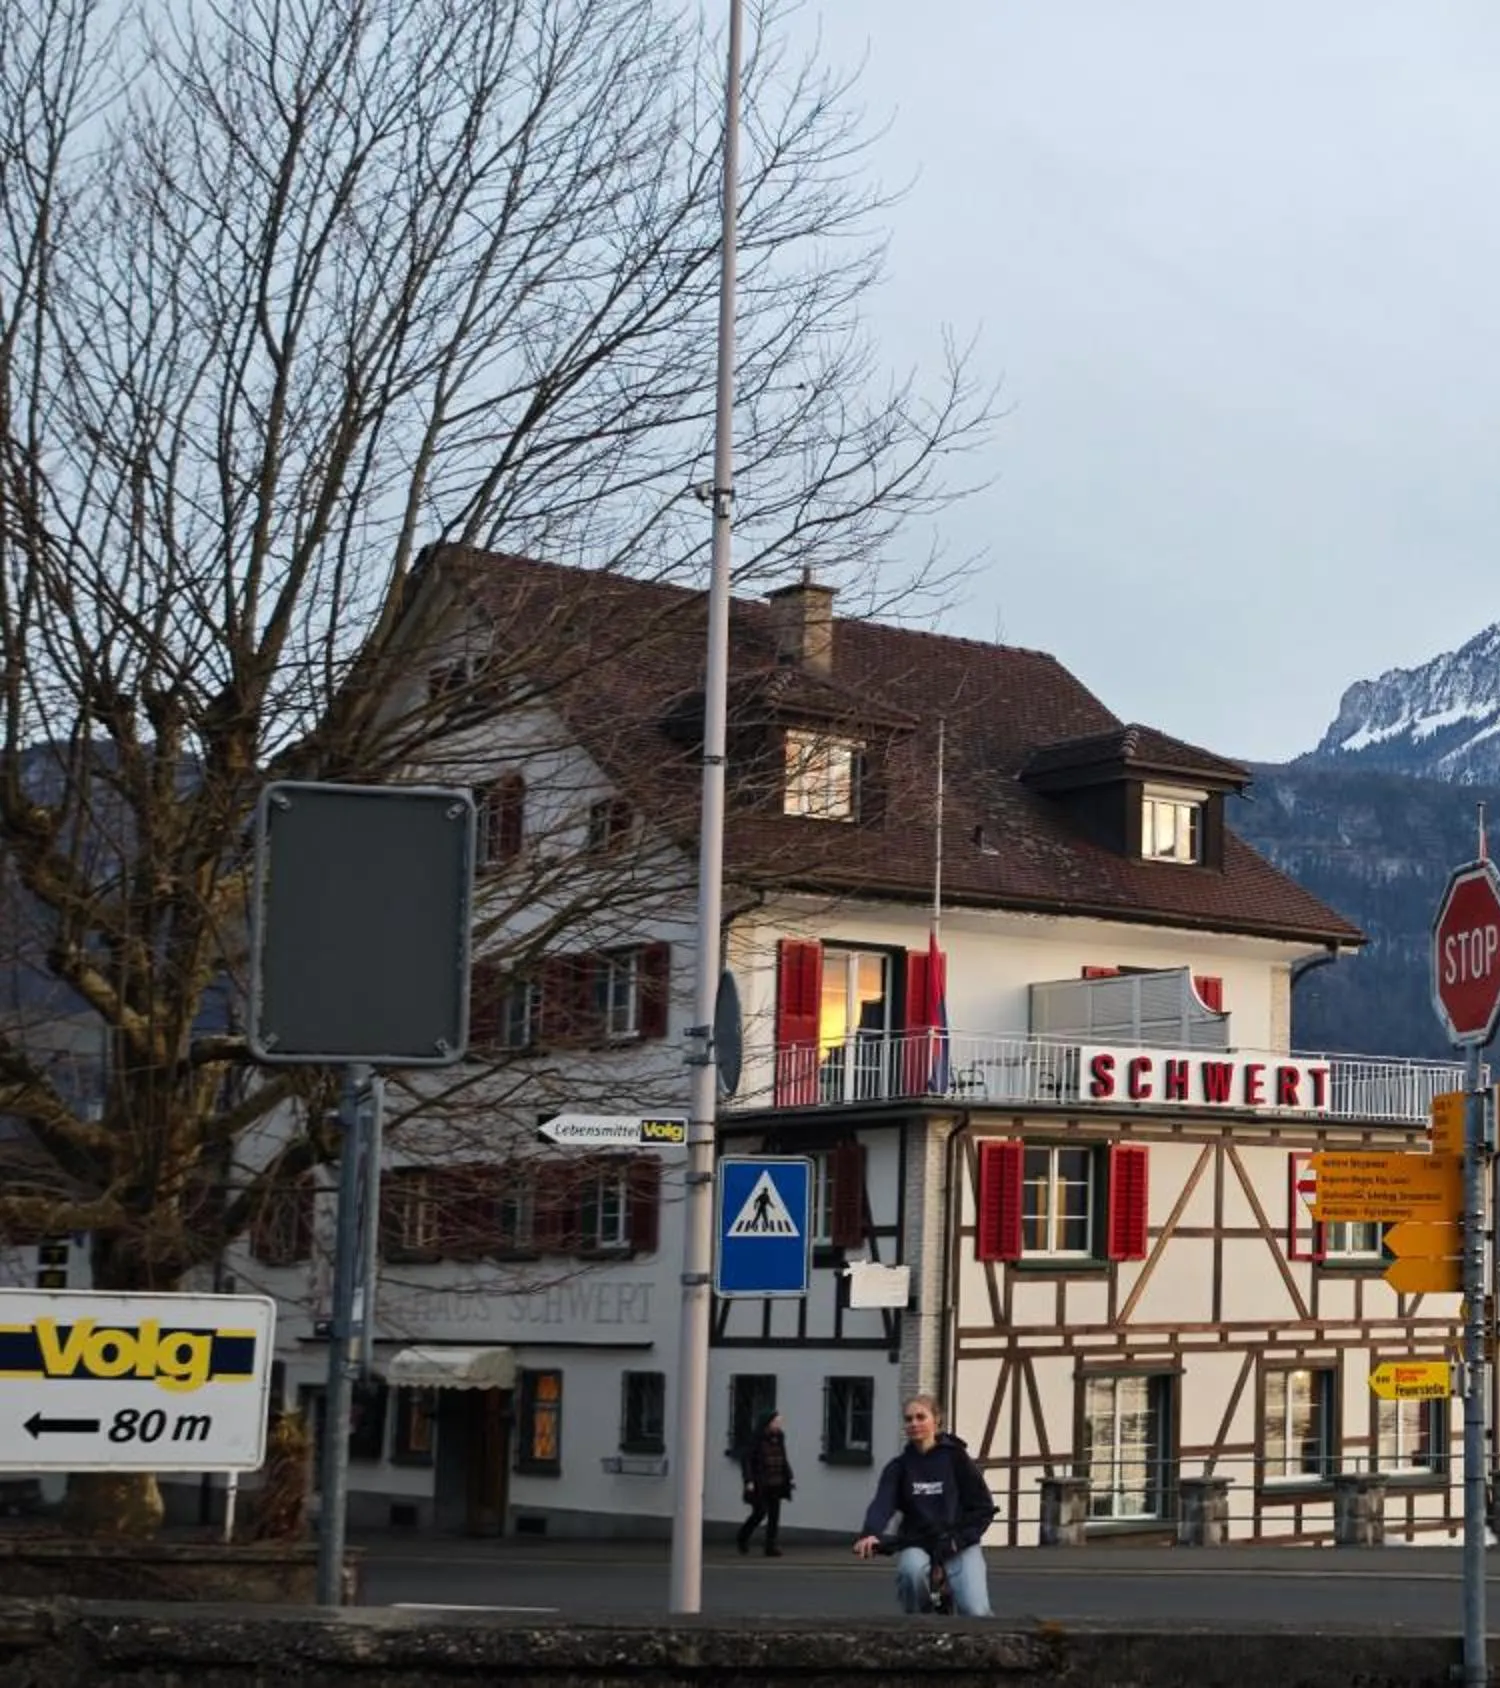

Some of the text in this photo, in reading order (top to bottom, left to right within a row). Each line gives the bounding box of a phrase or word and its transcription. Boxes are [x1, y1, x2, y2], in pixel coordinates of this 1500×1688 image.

[1445, 924, 1498, 985] STOP
[1089, 1053, 1330, 1107] SCHWERT
[554, 1121, 684, 1142] Lebensmittel Volg
[507, 1281, 655, 1324] SCHWERT
[34, 1315, 215, 1395] Volg
[107, 1408, 212, 1443] 80 m
